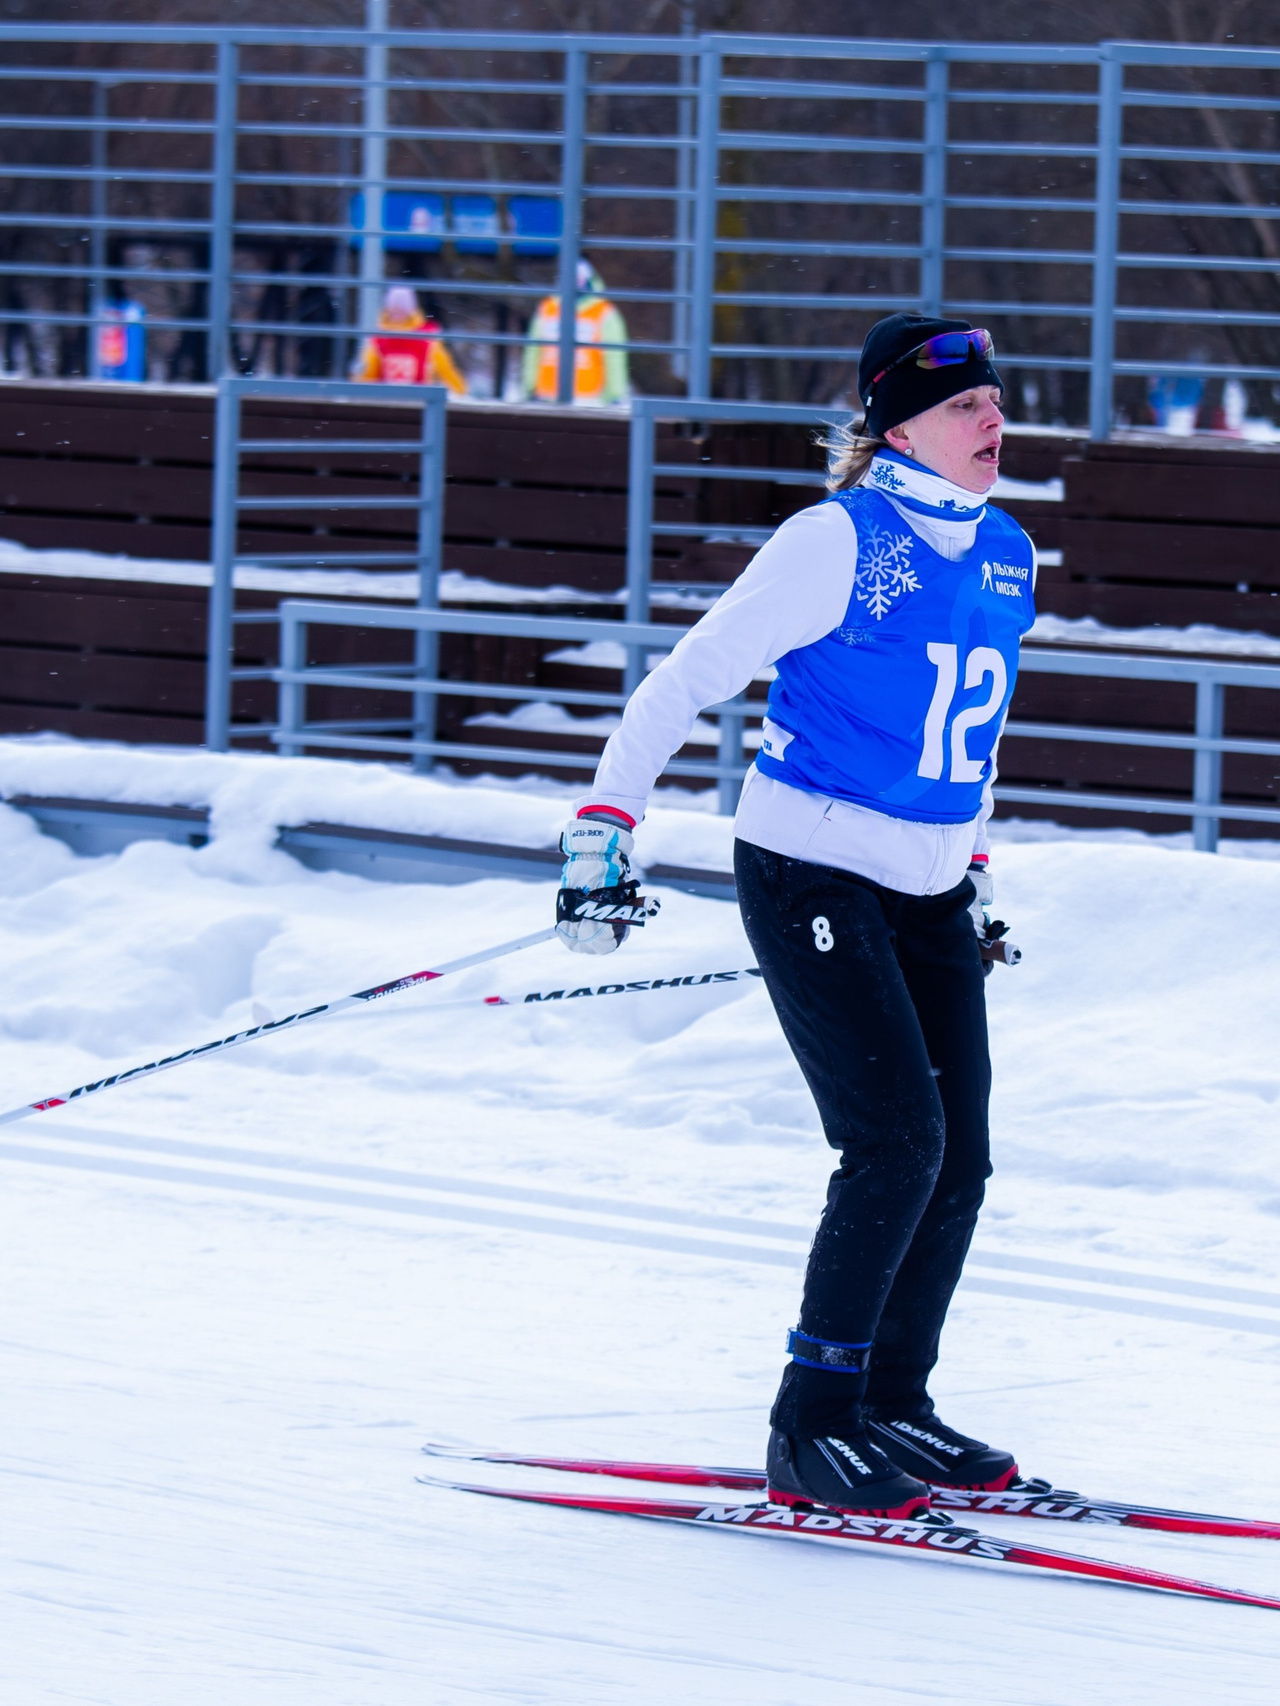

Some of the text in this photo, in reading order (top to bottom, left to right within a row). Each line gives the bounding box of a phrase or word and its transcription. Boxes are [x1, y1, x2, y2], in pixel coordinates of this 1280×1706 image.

[993, 562, 1029, 581] ЛЫЖНЯ
[995, 581, 1022, 597] МОЭК
[917, 642, 1007, 783] 12
[812, 916, 834, 952] 8
[523, 970, 739, 1004] MADSHUS
[826, 1436, 873, 1475] SHUS
[891, 1420, 964, 1457] DSHUS
[931, 1491, 1128, 1527] SHUS
[695, 1506, 1013, 1561] MADSHUS
